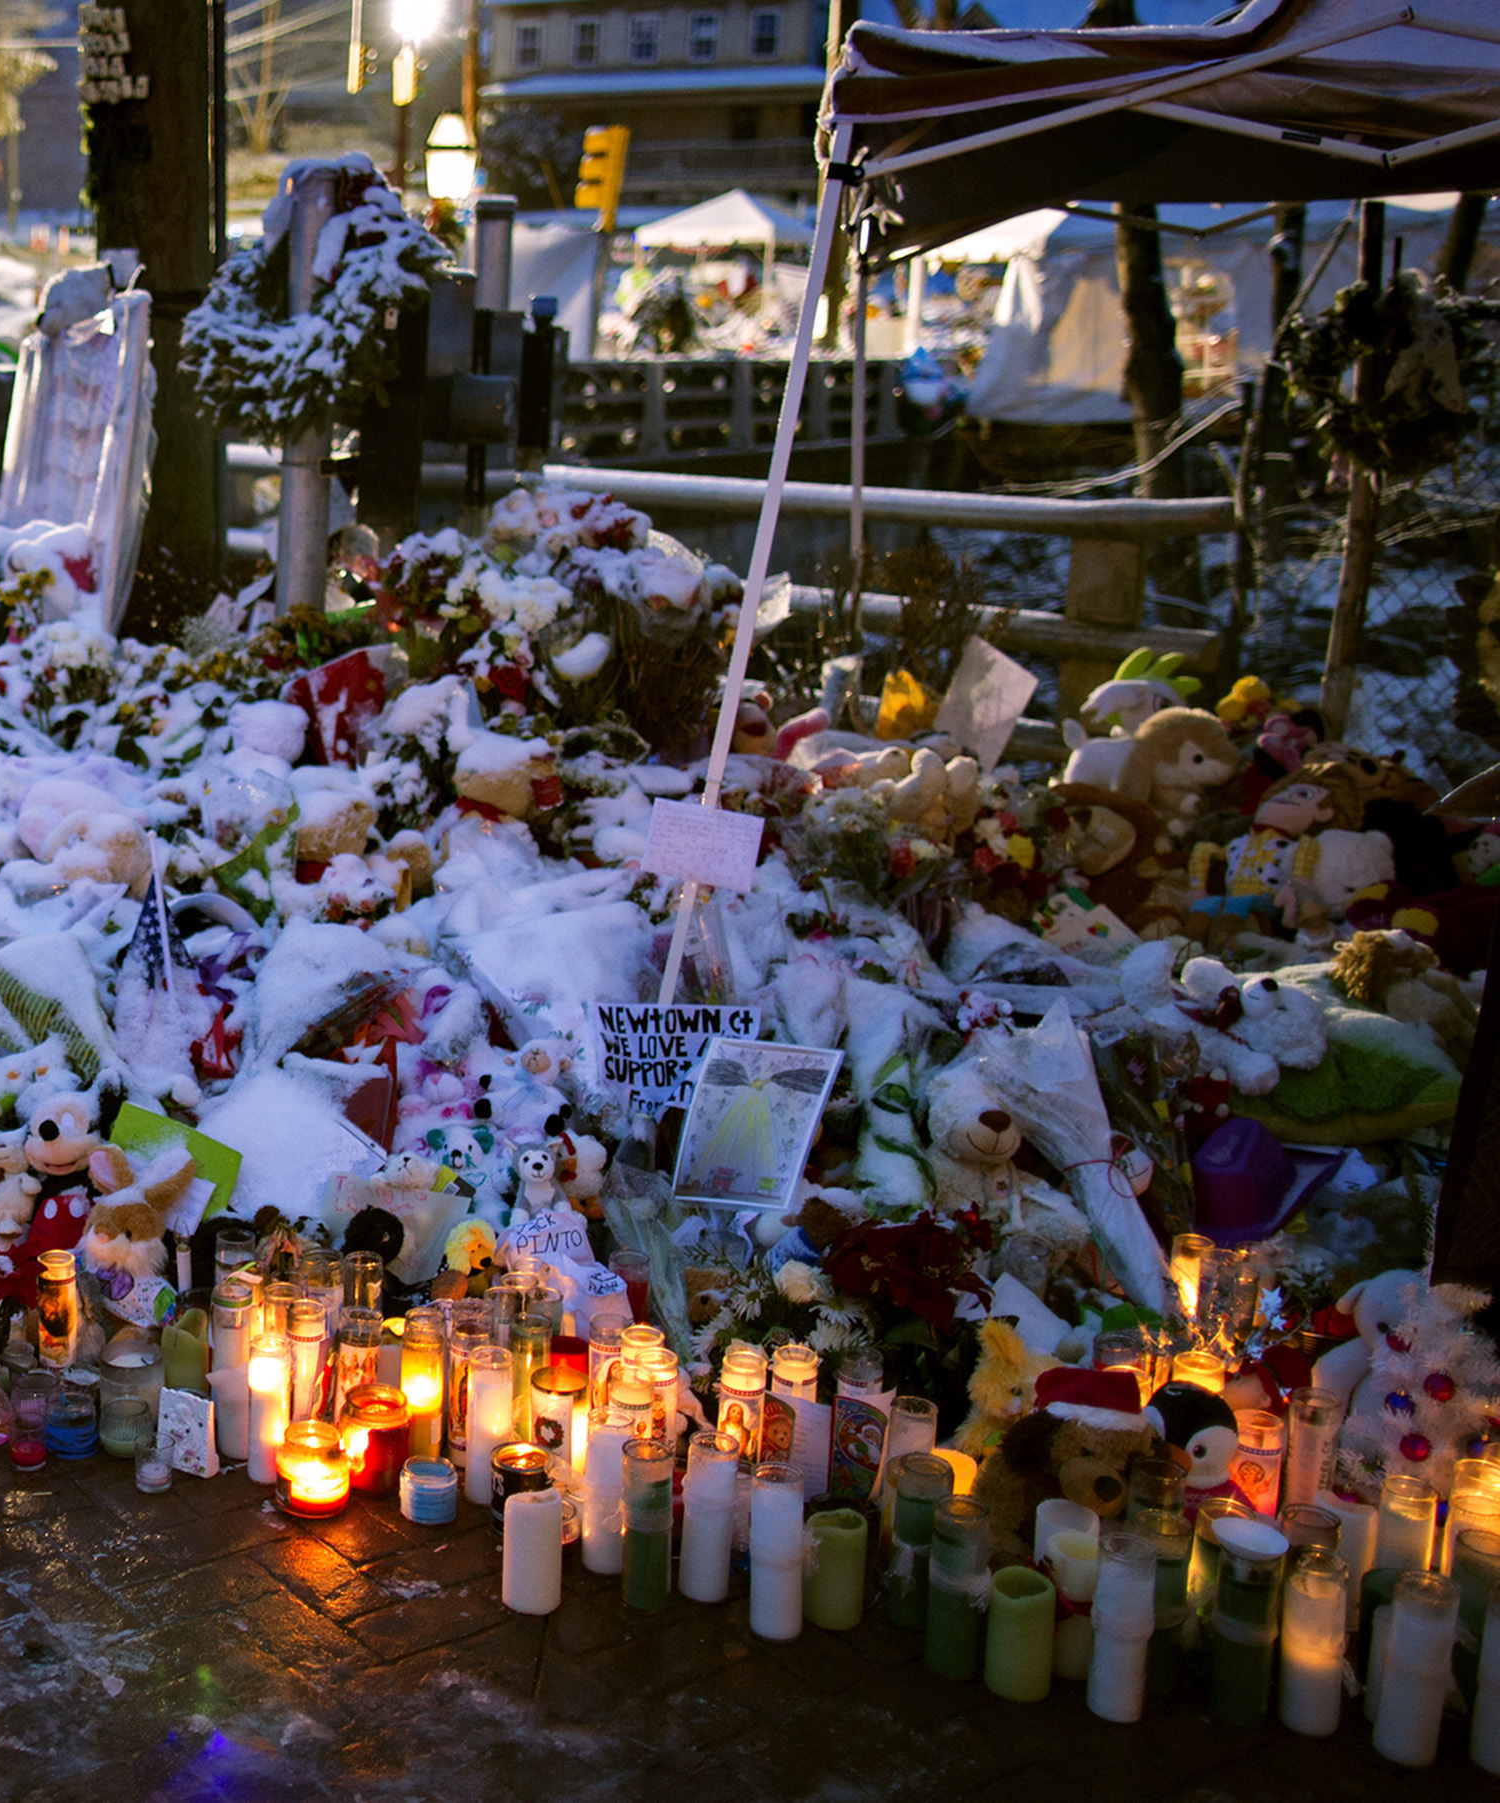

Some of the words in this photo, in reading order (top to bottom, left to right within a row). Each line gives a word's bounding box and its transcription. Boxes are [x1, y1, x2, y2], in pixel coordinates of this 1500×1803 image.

[600, 1032, 632, 1057] WE
[638, 1036, 688, 1059] LOVE
[516, 1213, 557, 1236] JACK
[516, 1229, 583, 1255] PINTO
